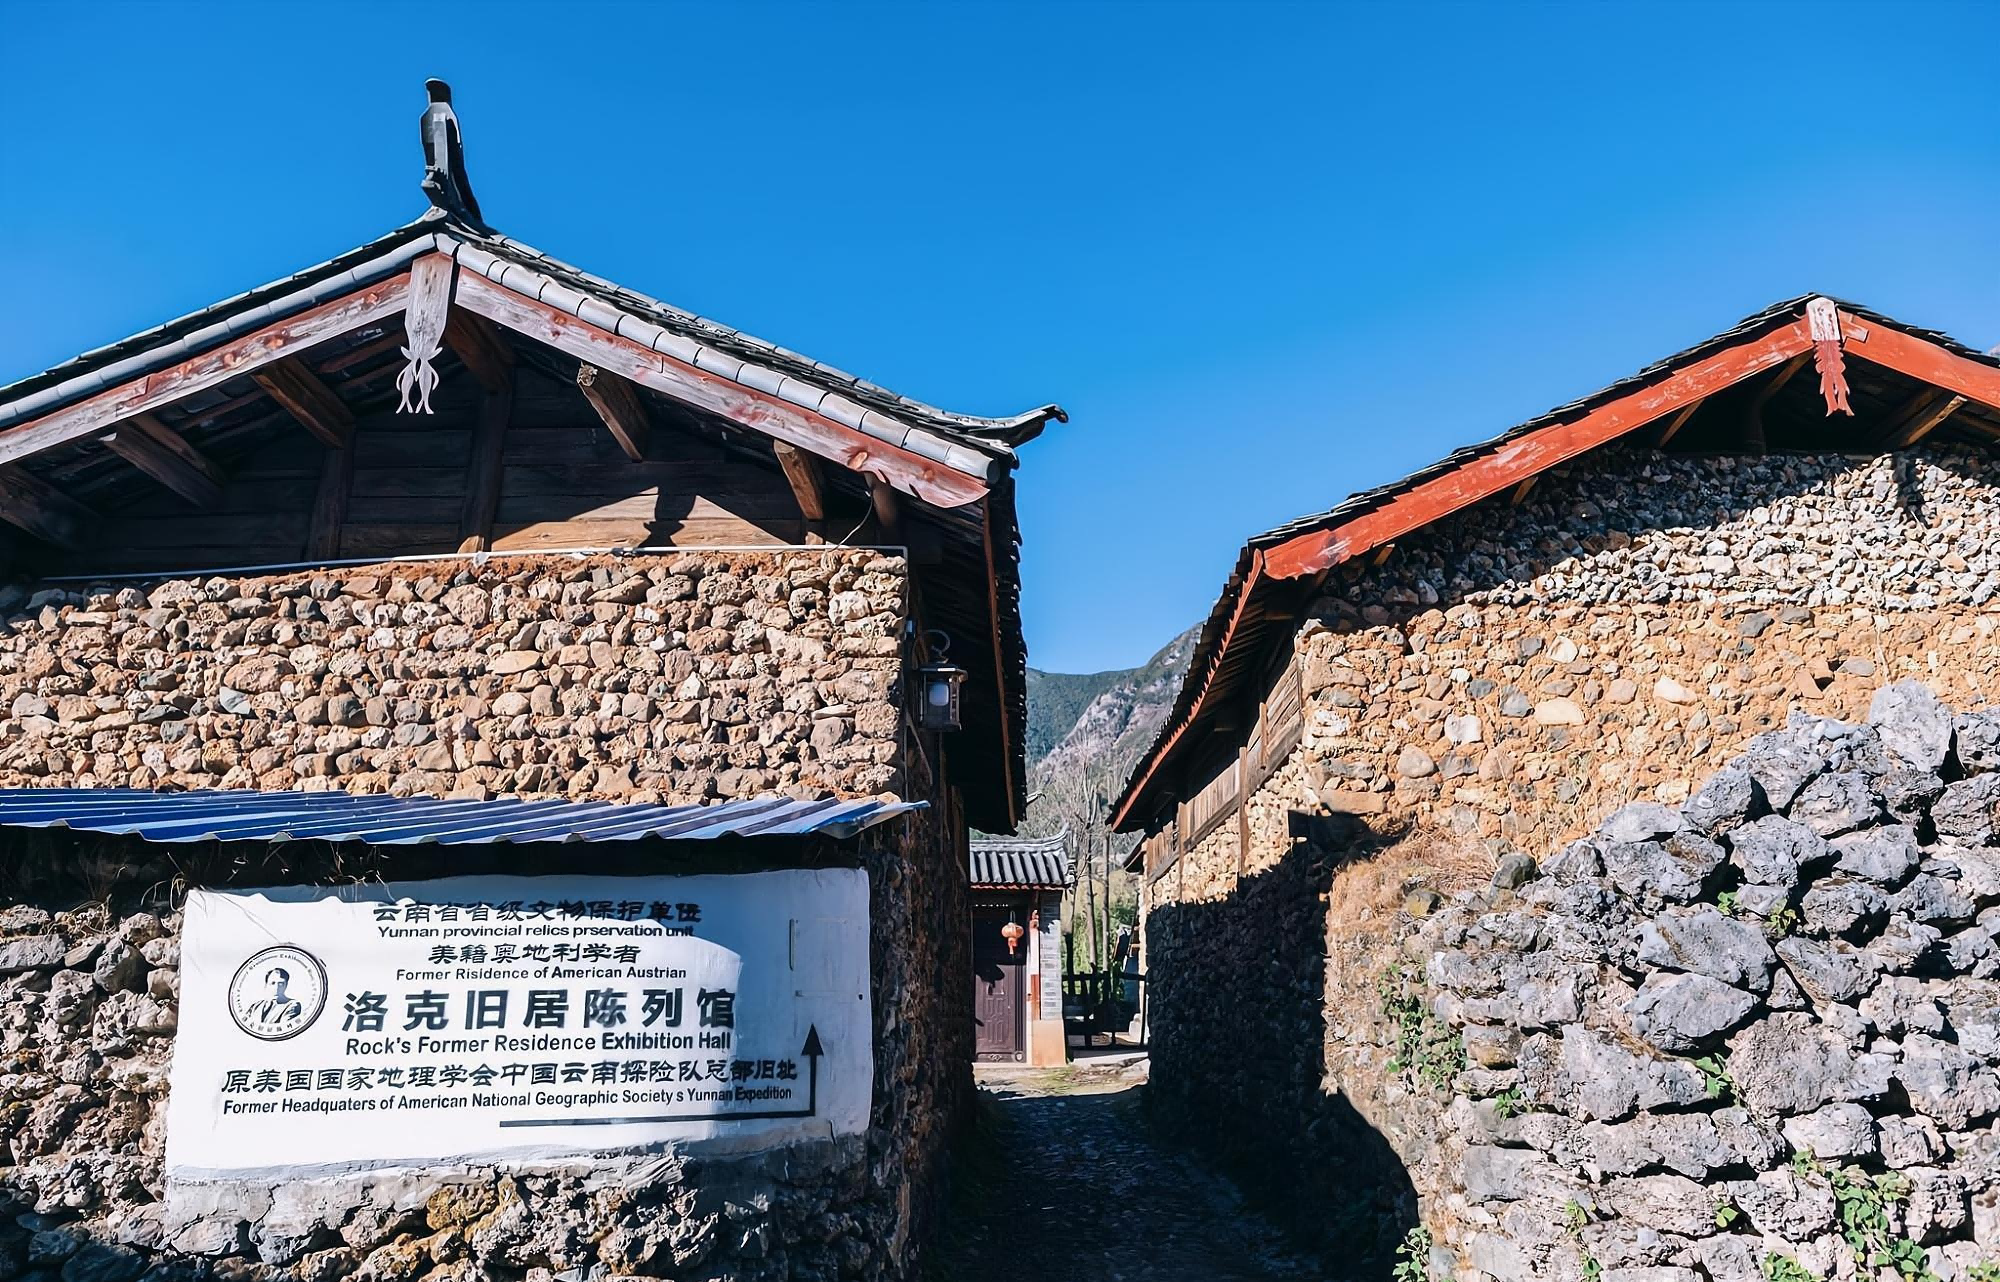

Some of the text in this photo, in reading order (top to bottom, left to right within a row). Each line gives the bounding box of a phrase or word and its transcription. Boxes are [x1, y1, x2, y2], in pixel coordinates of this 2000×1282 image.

[378, 924, 695, 939] Yunnan provincial relics prservation unit
[428, 943, 641, 964] 美籍奥地利学者
[396, 966, 687, 981] Former Risidence of American Austrian
[341, 987, 736, 1032] 洛克旧居陈列馆
[345, 1031, 731, 1055] Rock's Former Residence Exhibition Hall
[223, 1099, 278, 1115] Former
[281, 1097, 376, 1115] Headquaters
[379, 1095, 397, 1110] of
[397, 1094, 467, 1110] American
[472, 1091, 531, 1107] National
[535, 1089, 619, 1108] Geographic
[622, 1089, 673, 1106] Society
[687, 1087, 733, 1102] Yunnan
[735, 1085, 792, 1103] Expedition
